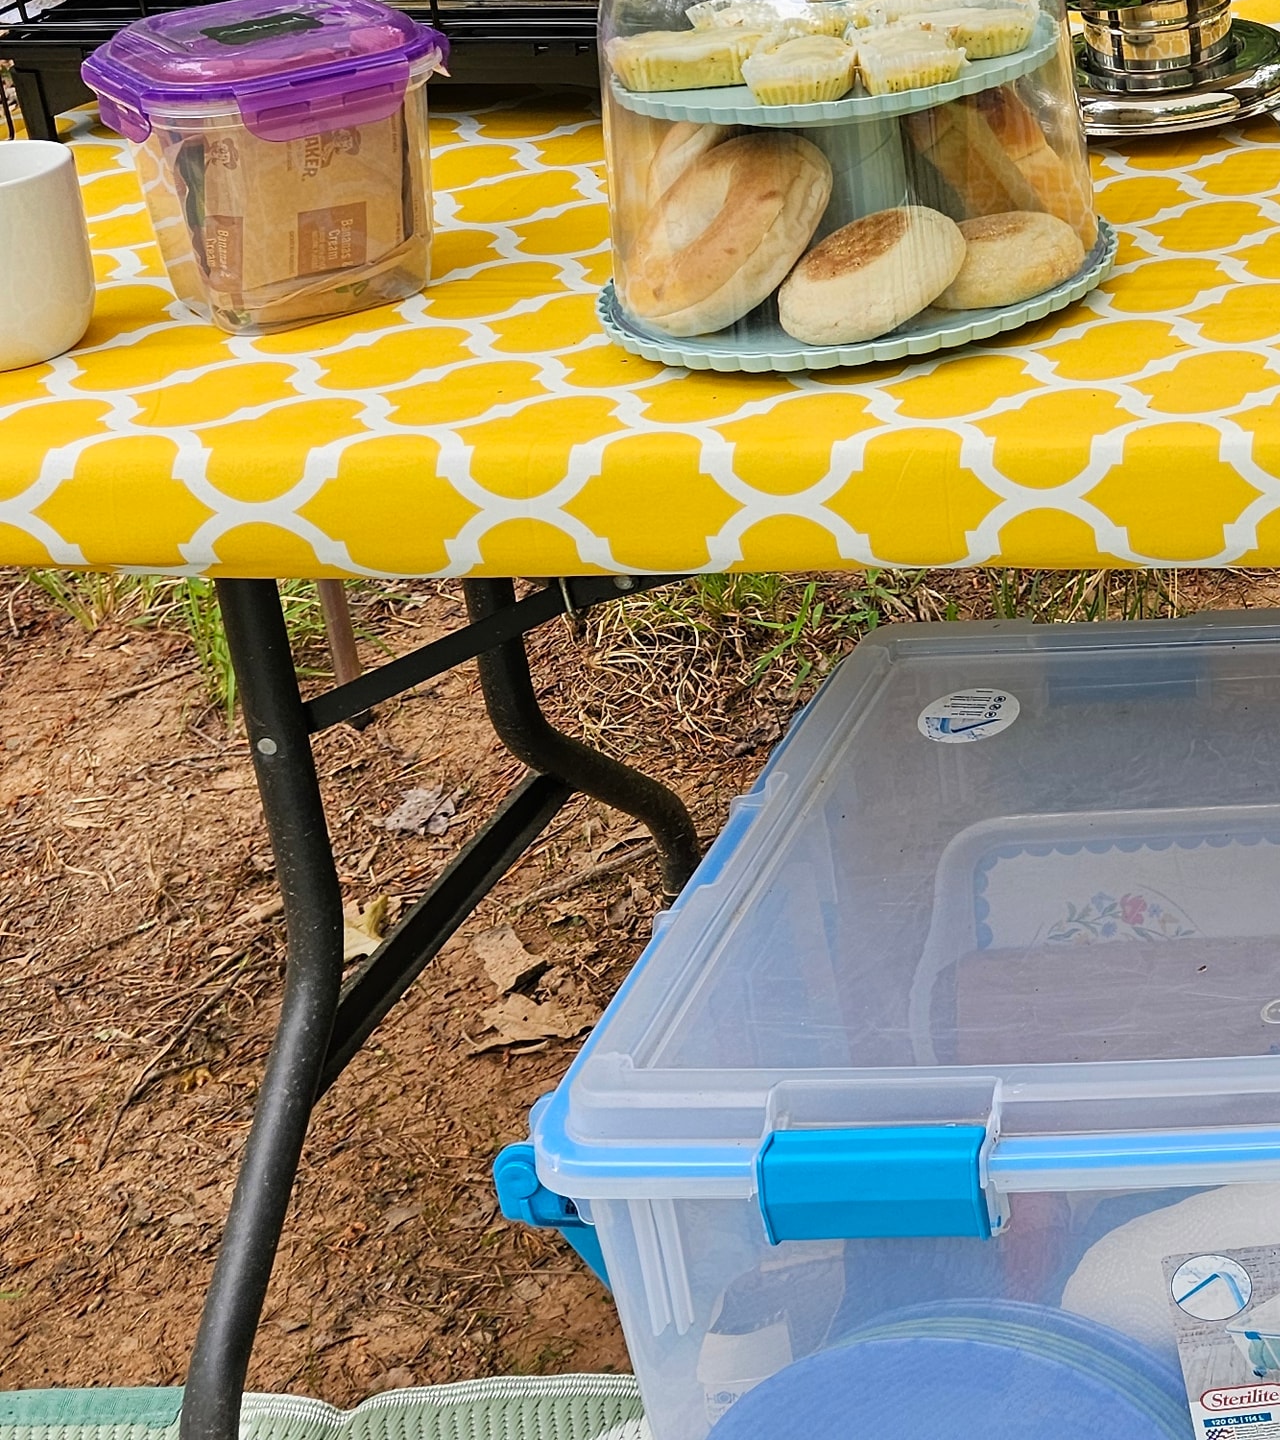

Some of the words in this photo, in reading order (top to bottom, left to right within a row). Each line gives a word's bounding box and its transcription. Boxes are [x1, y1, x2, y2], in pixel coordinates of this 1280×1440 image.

[328, 229, 340, 260] Cream
[341, 218, 353, 261] Bananas
[1211, 1388, 1280, 1409] Sterilite
